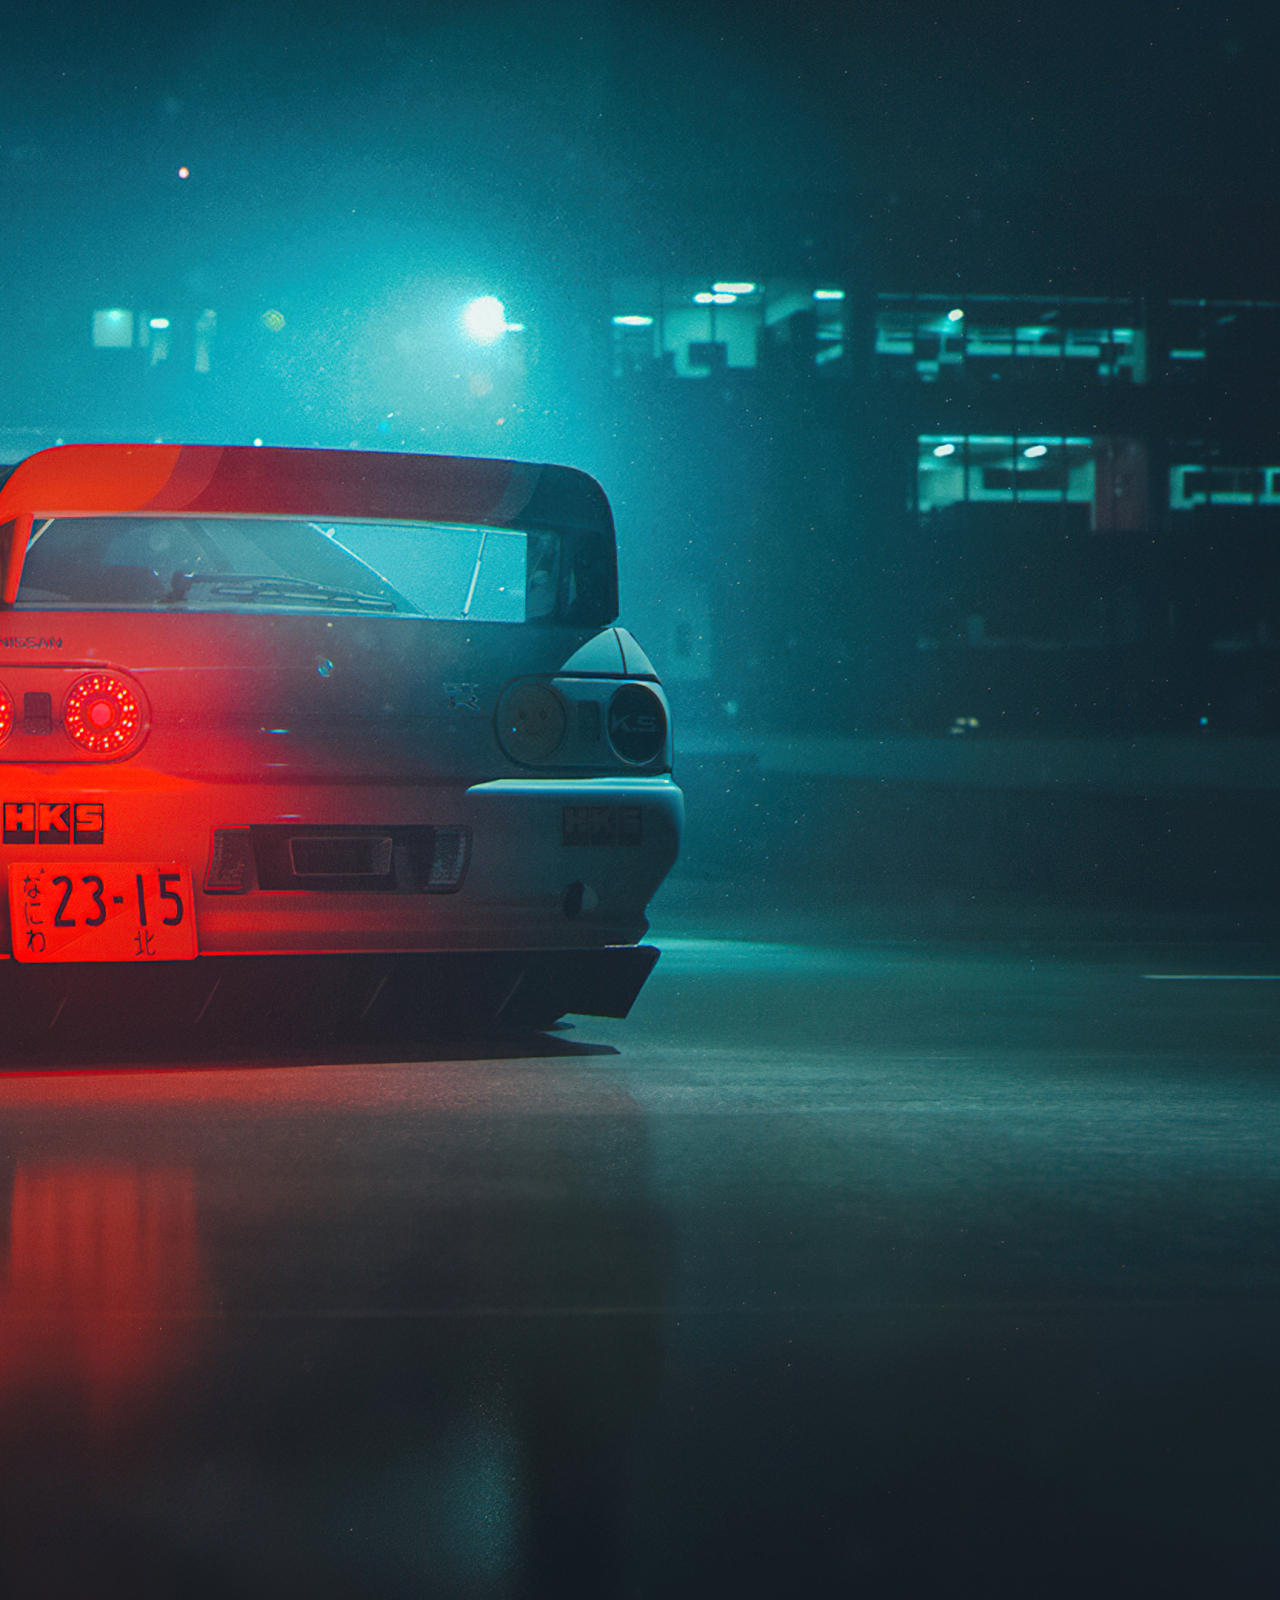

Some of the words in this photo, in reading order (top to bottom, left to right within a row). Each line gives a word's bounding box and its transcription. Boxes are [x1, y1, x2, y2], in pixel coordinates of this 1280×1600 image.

[4, 803, 104, 833] HKS
[563, 806, 642, 834] HKS
[23, 875, 46, 952] なにわ
[52, 873, 184, 927] 23-15
[134, 929, 156, 956] 北
